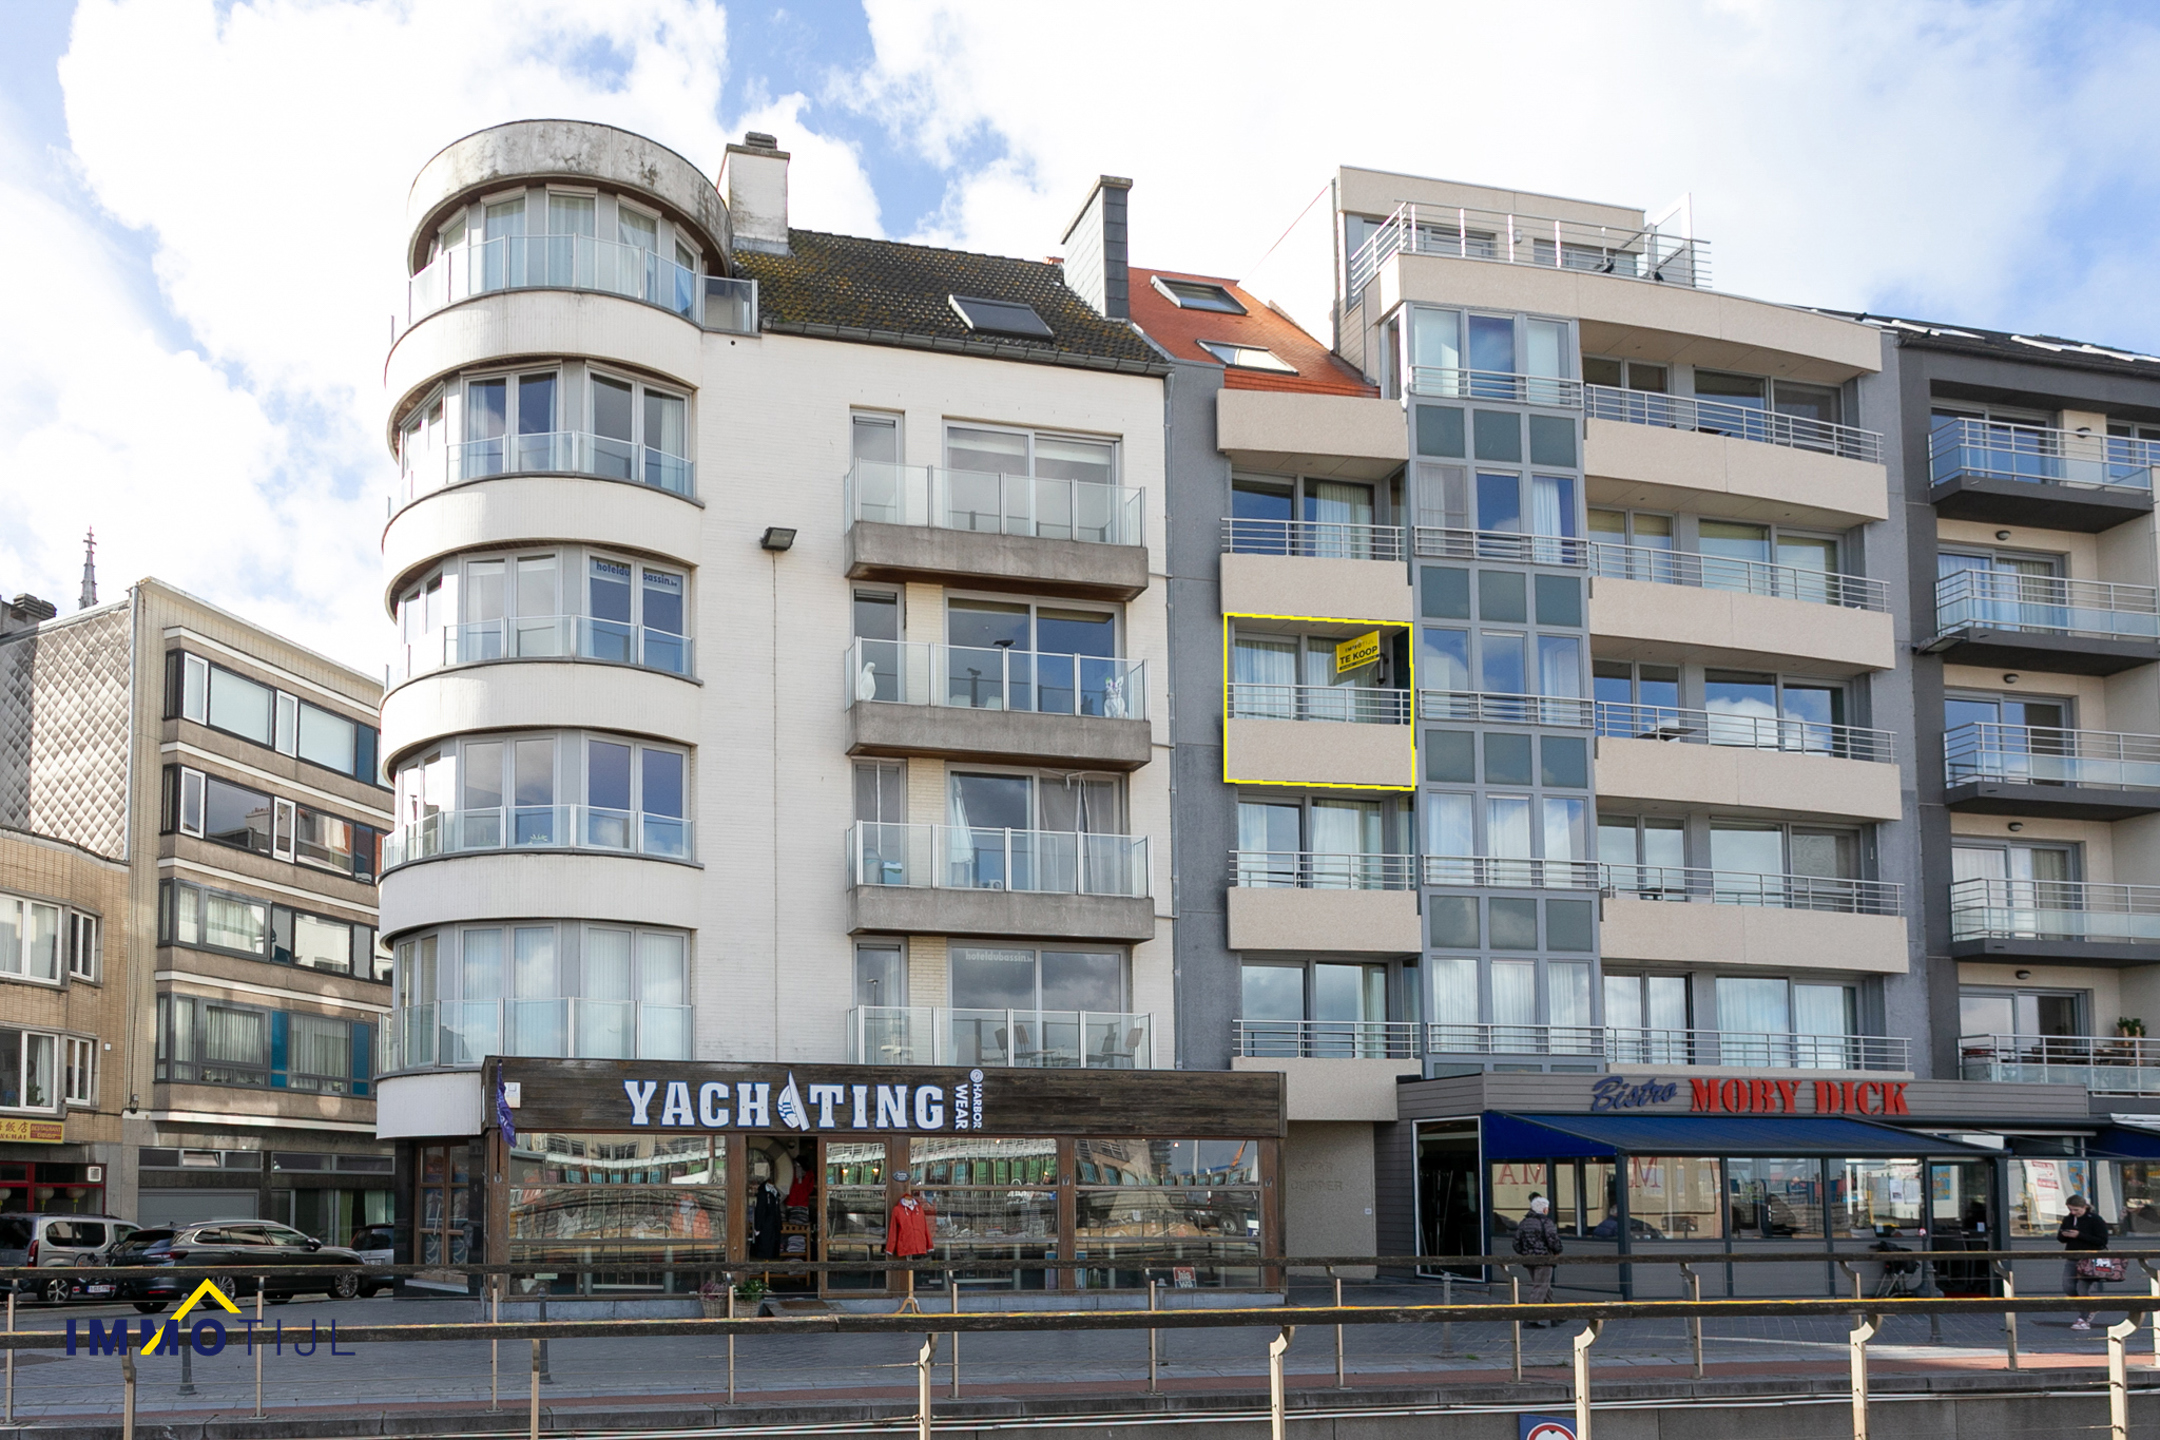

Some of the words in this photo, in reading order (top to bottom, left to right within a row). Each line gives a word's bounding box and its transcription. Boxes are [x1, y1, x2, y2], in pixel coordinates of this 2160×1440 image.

[1339, 653, 1351, 665] TE
[1352, 644, 1378, 660] KOOP
[623, 1079, 945, 1131] YACHTING
[955, 1083, 969, 1131] WEAR
[972, 1083, 983, 1130] HARBOR
[1591, 1075, 1678, 1112] Bistro
[1689, 1077, 1802, 1114] MOBY
[1813, 1080, 1911, 1116] DICK
